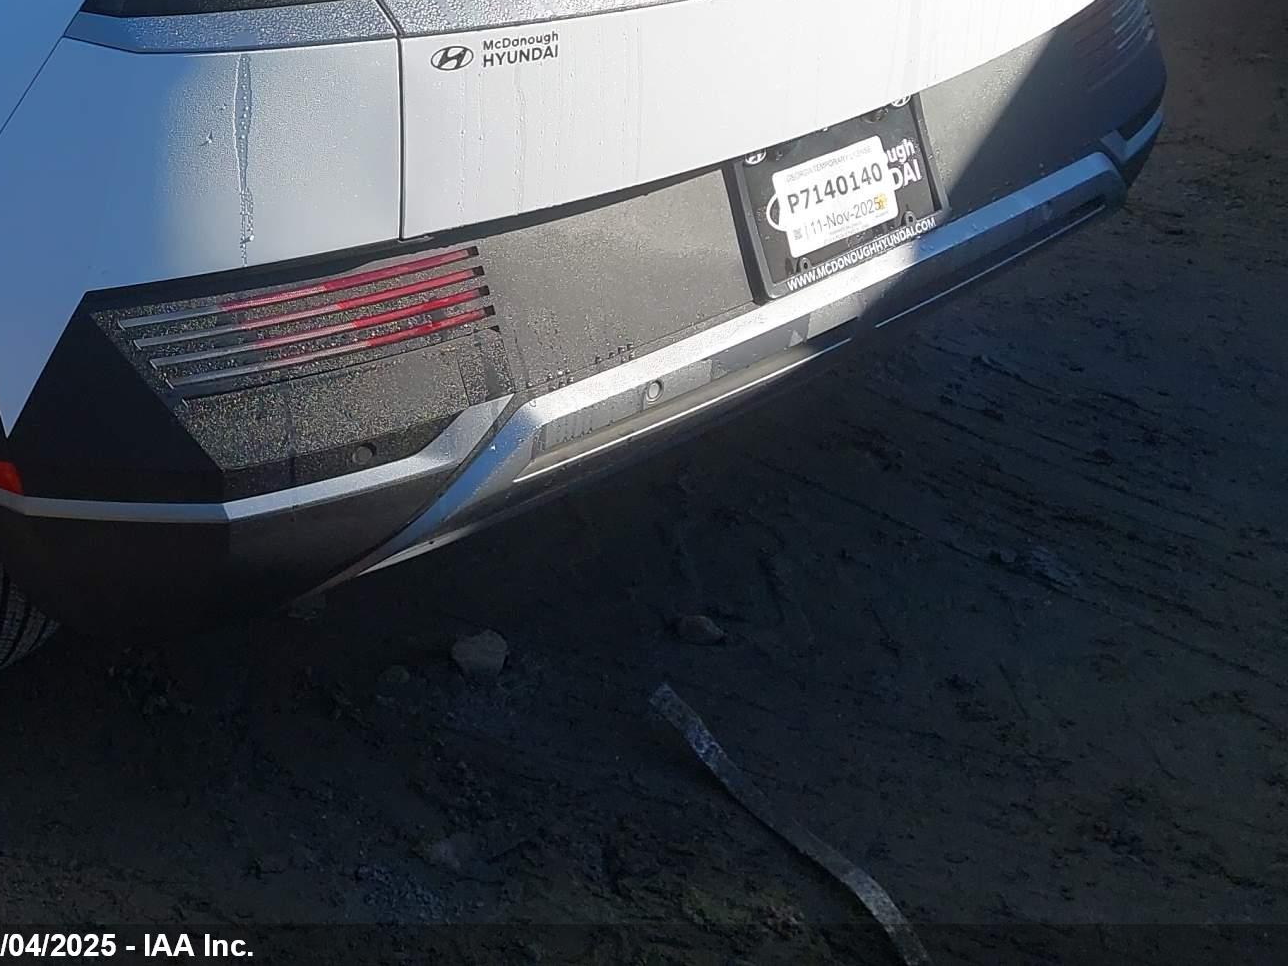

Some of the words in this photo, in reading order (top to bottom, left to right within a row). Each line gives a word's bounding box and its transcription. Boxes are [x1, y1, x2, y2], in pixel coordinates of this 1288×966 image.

[483, 31, 559, 50] McDonough
[483, 45, 559, 68] HYUNDAI
[787, 162, 883, 214] P7140140
[810, 196, 881, 235] 11-Nov-2025
[787, 217, 937, 291] WWW.MCDONOUGHHYUNDAI.COM
